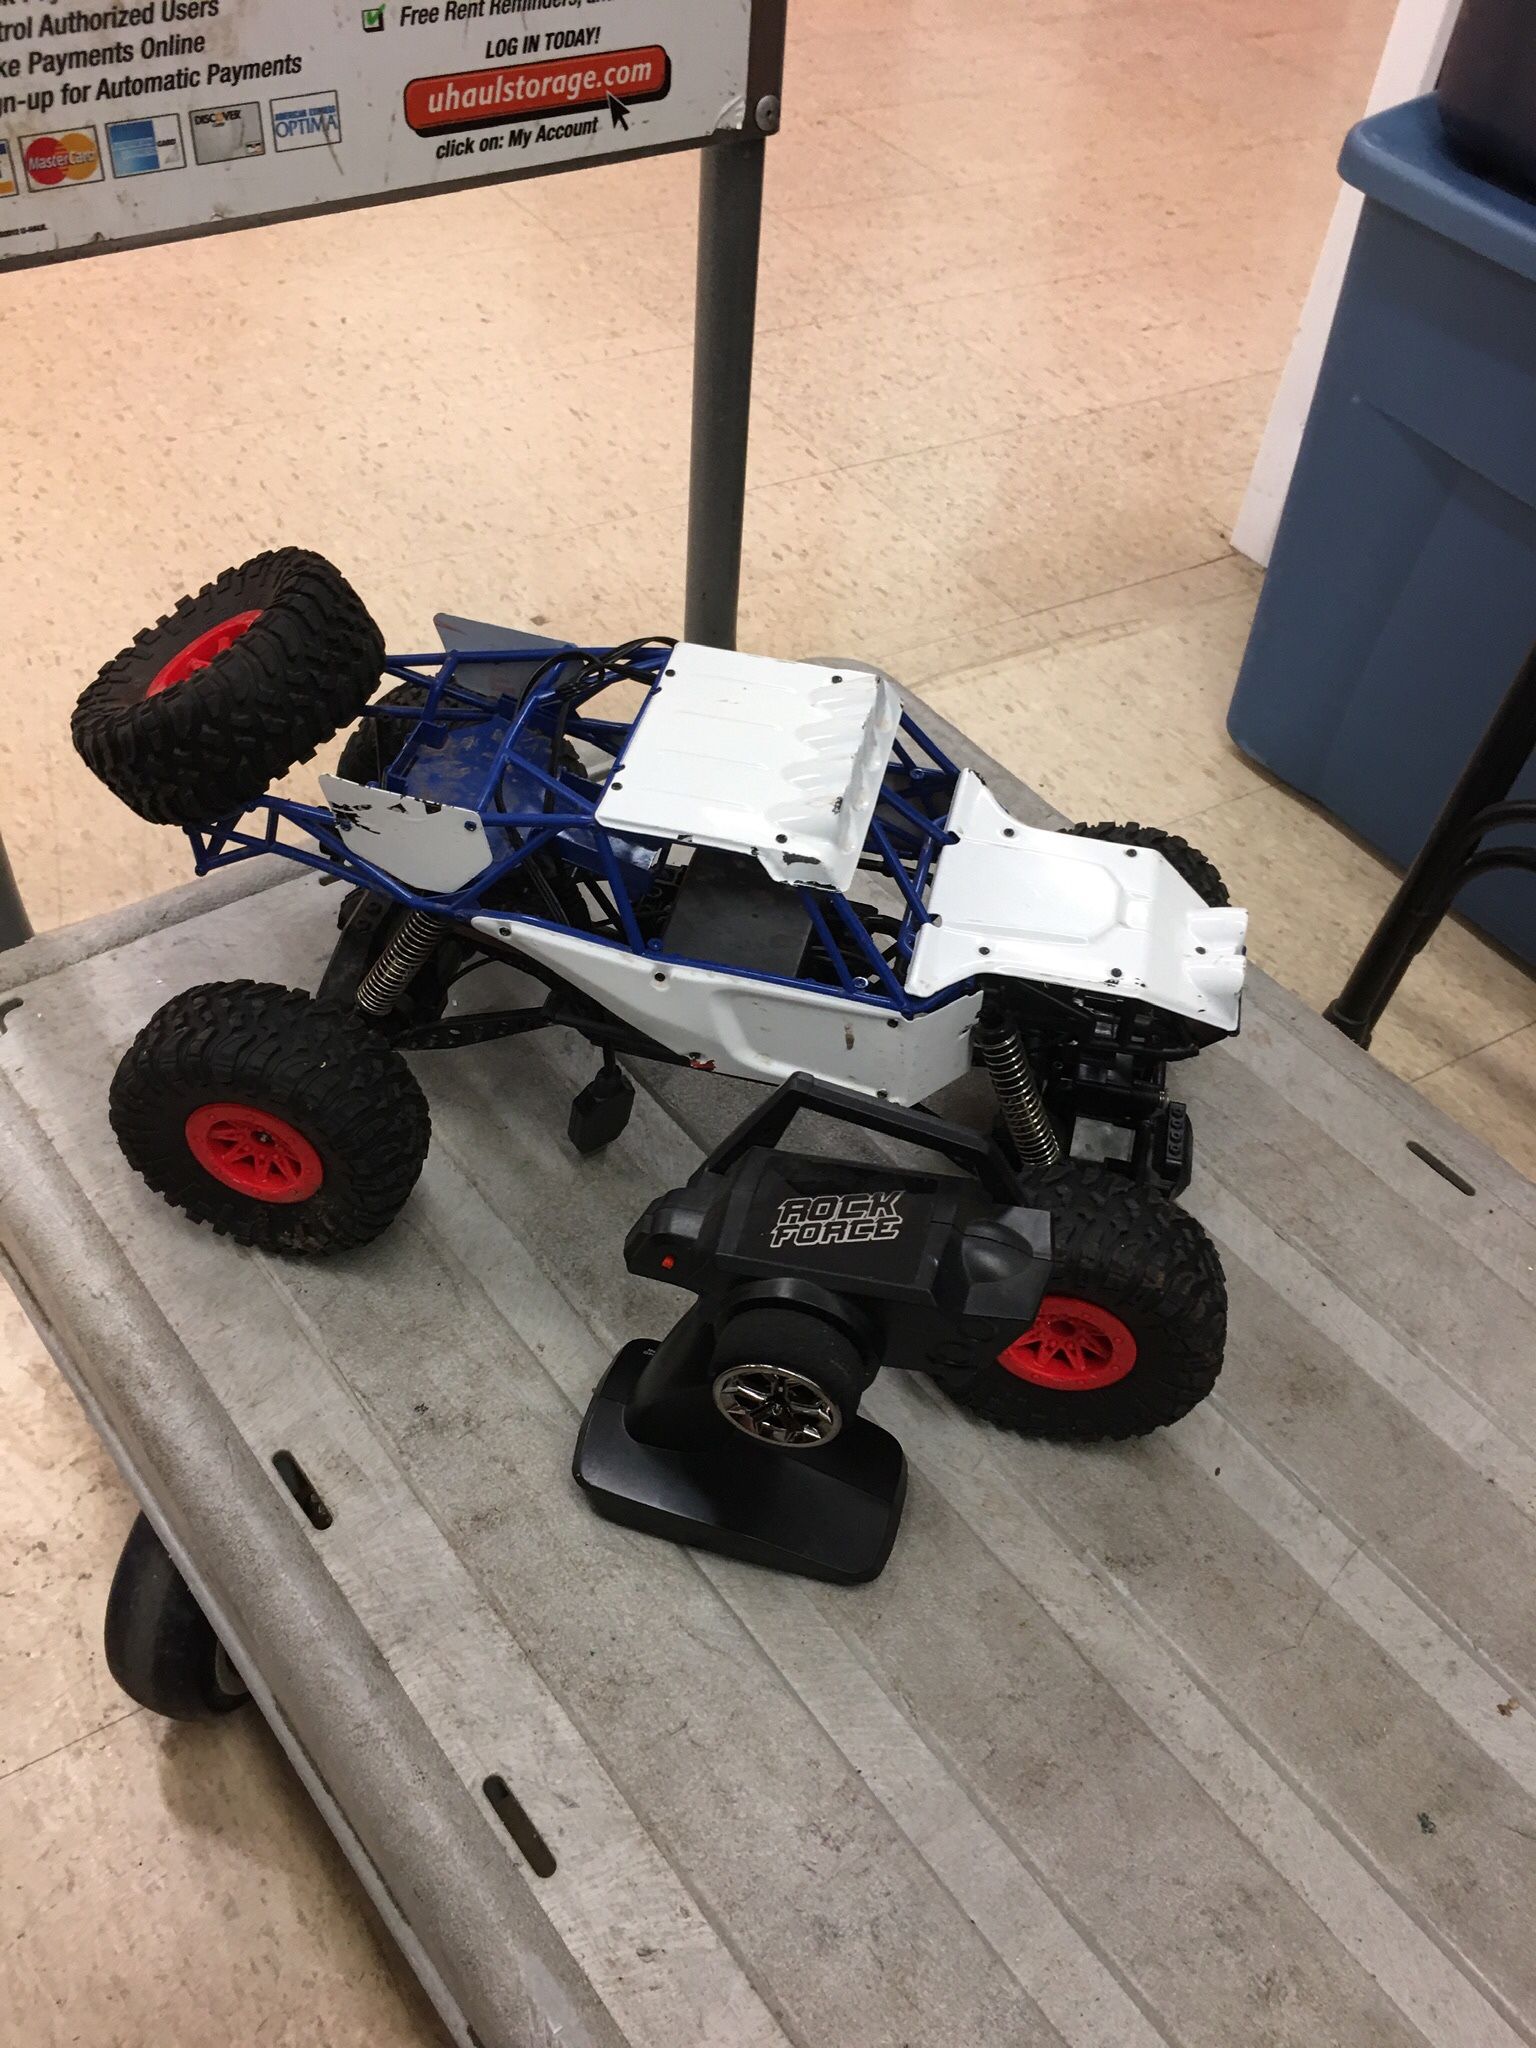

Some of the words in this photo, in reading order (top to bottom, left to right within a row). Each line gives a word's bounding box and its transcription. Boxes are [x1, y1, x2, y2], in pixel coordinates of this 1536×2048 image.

[38, 2, 155, 38] Authorized
[161, 0, 219, 22] Users
[400, 6, 439, 26] Free
[444, 0, 485, 21] Rent
[28, 41, 134, 76] Payments
[141, 34, 206, 60] Online
[485, 37, 518, 59] LOG
[522, 34, 541, 54] IN
[545, 26, 602, 50] TODAY!
[60, 83, 92, 105] for
[96, 67, 200, 101] Automatic
[207, 54, 302, 87] Payments
[427, 61, 652, 114] uhaulstorage.com
[275, 113, 339, 138] OPTIMA
[435, 138, 475, 160] click
[479, 137, 503, 153] on:
[508, 127, 533, 149] My
[535, 116, 599, 143] Account
[777, 1190, 906, 1225] ROCK
[769, 1215, 904, 1248] FORCE
